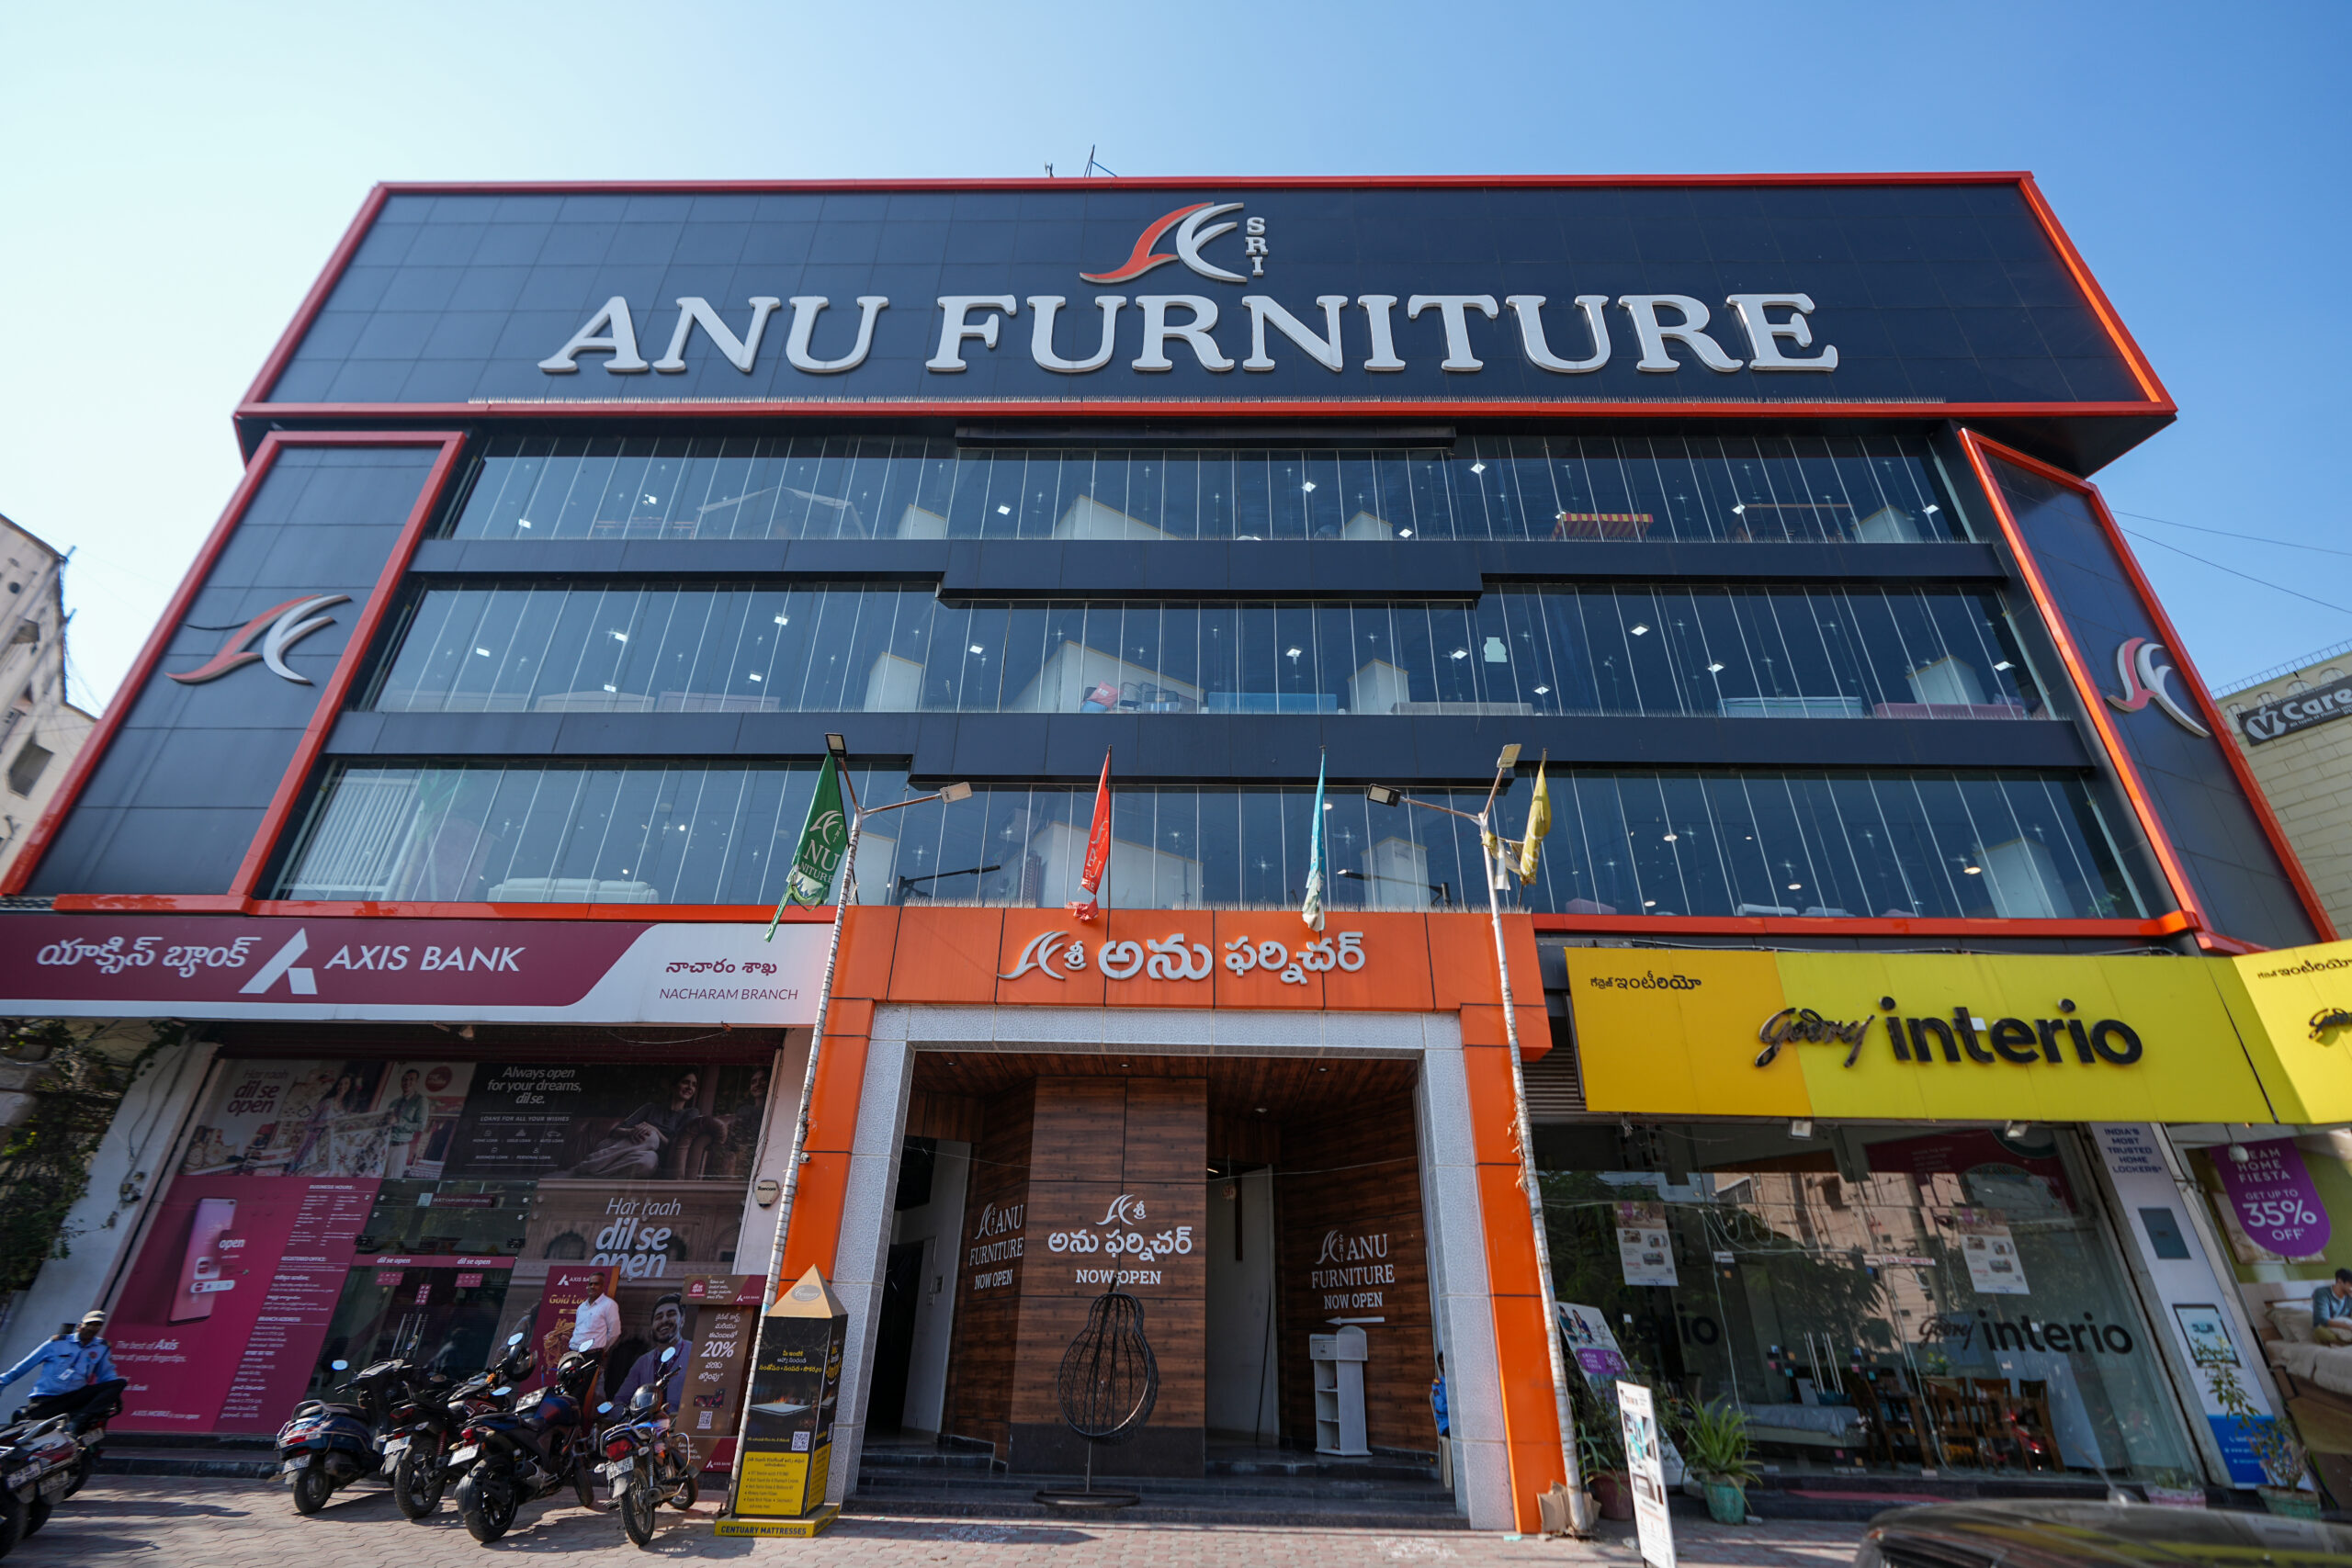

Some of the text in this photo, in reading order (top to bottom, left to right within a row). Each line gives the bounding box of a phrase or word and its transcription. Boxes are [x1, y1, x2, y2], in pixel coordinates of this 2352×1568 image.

[1246, 216, 1269, 276] SRI
[537, 293, 1838, 374] ANU FURNITURE
[323, 945, 526, 973] AXIS BANK
[1098, 932, 1213, 981] అను
[1224, 931, 1366, 985] ఫర్నిచర్
[664, 960, 778, 976] నాచారం శాఖ
[658, 987, 799, 1001] NACHARAM BRANCH
[1878, 995, 2144, 1066] interio
[502, 1066, 576, 1080] Always open
[233, 1079, 280, 1099] dil se
[487, 1078, 582, 1093] for your dreams,
[515, 1091, 530, 1104] dil
[227, 1099, 275, 1117] open
[2107, 1146, 2154, 1155] TRUSTED
[2111, 1137, 2141, 1145] MOST
[2119, 1156, 2149, 1164] HOME
[2236, 1159, 2283, 1173] HOME
[2238, 1169, 2291, 1184] FIESTA
[2245, 1188, 2300, 1201] GET UP TO
[605, 1197, 682, 1216] Har raah
[2242, 1199, 2318, 1228] 35%
[995, 1203, 1024, 1234] ANU
[595, 1217, 673, 1251] dil se
[1047, 1225, 1193, 1262] అను ఫర్నిచర్
[218, 1238, 246, 1251] open
[969, 1236, 1024, 1267] FURNITURE
[1346, 1233, 1388, 1261] ANU
[974, 1269, 1013, 1291] NOW OPEN
[1076, 1269, 1162, 1285] NOW OPEN
[1311, 1263, 1396, 1290] FURNITURE
[548, 1293, 571, 1304] Gold
[1323, 1291, 1384, 1310] NOW OPEN
[1977, 1309, 2134, 1355] interio
[154, 1338, 180, 1351] Axis
[700, 1340, 738, 1359] 20%
[720, 1525, 807, 1536] CENTUARY MATTRESSES
